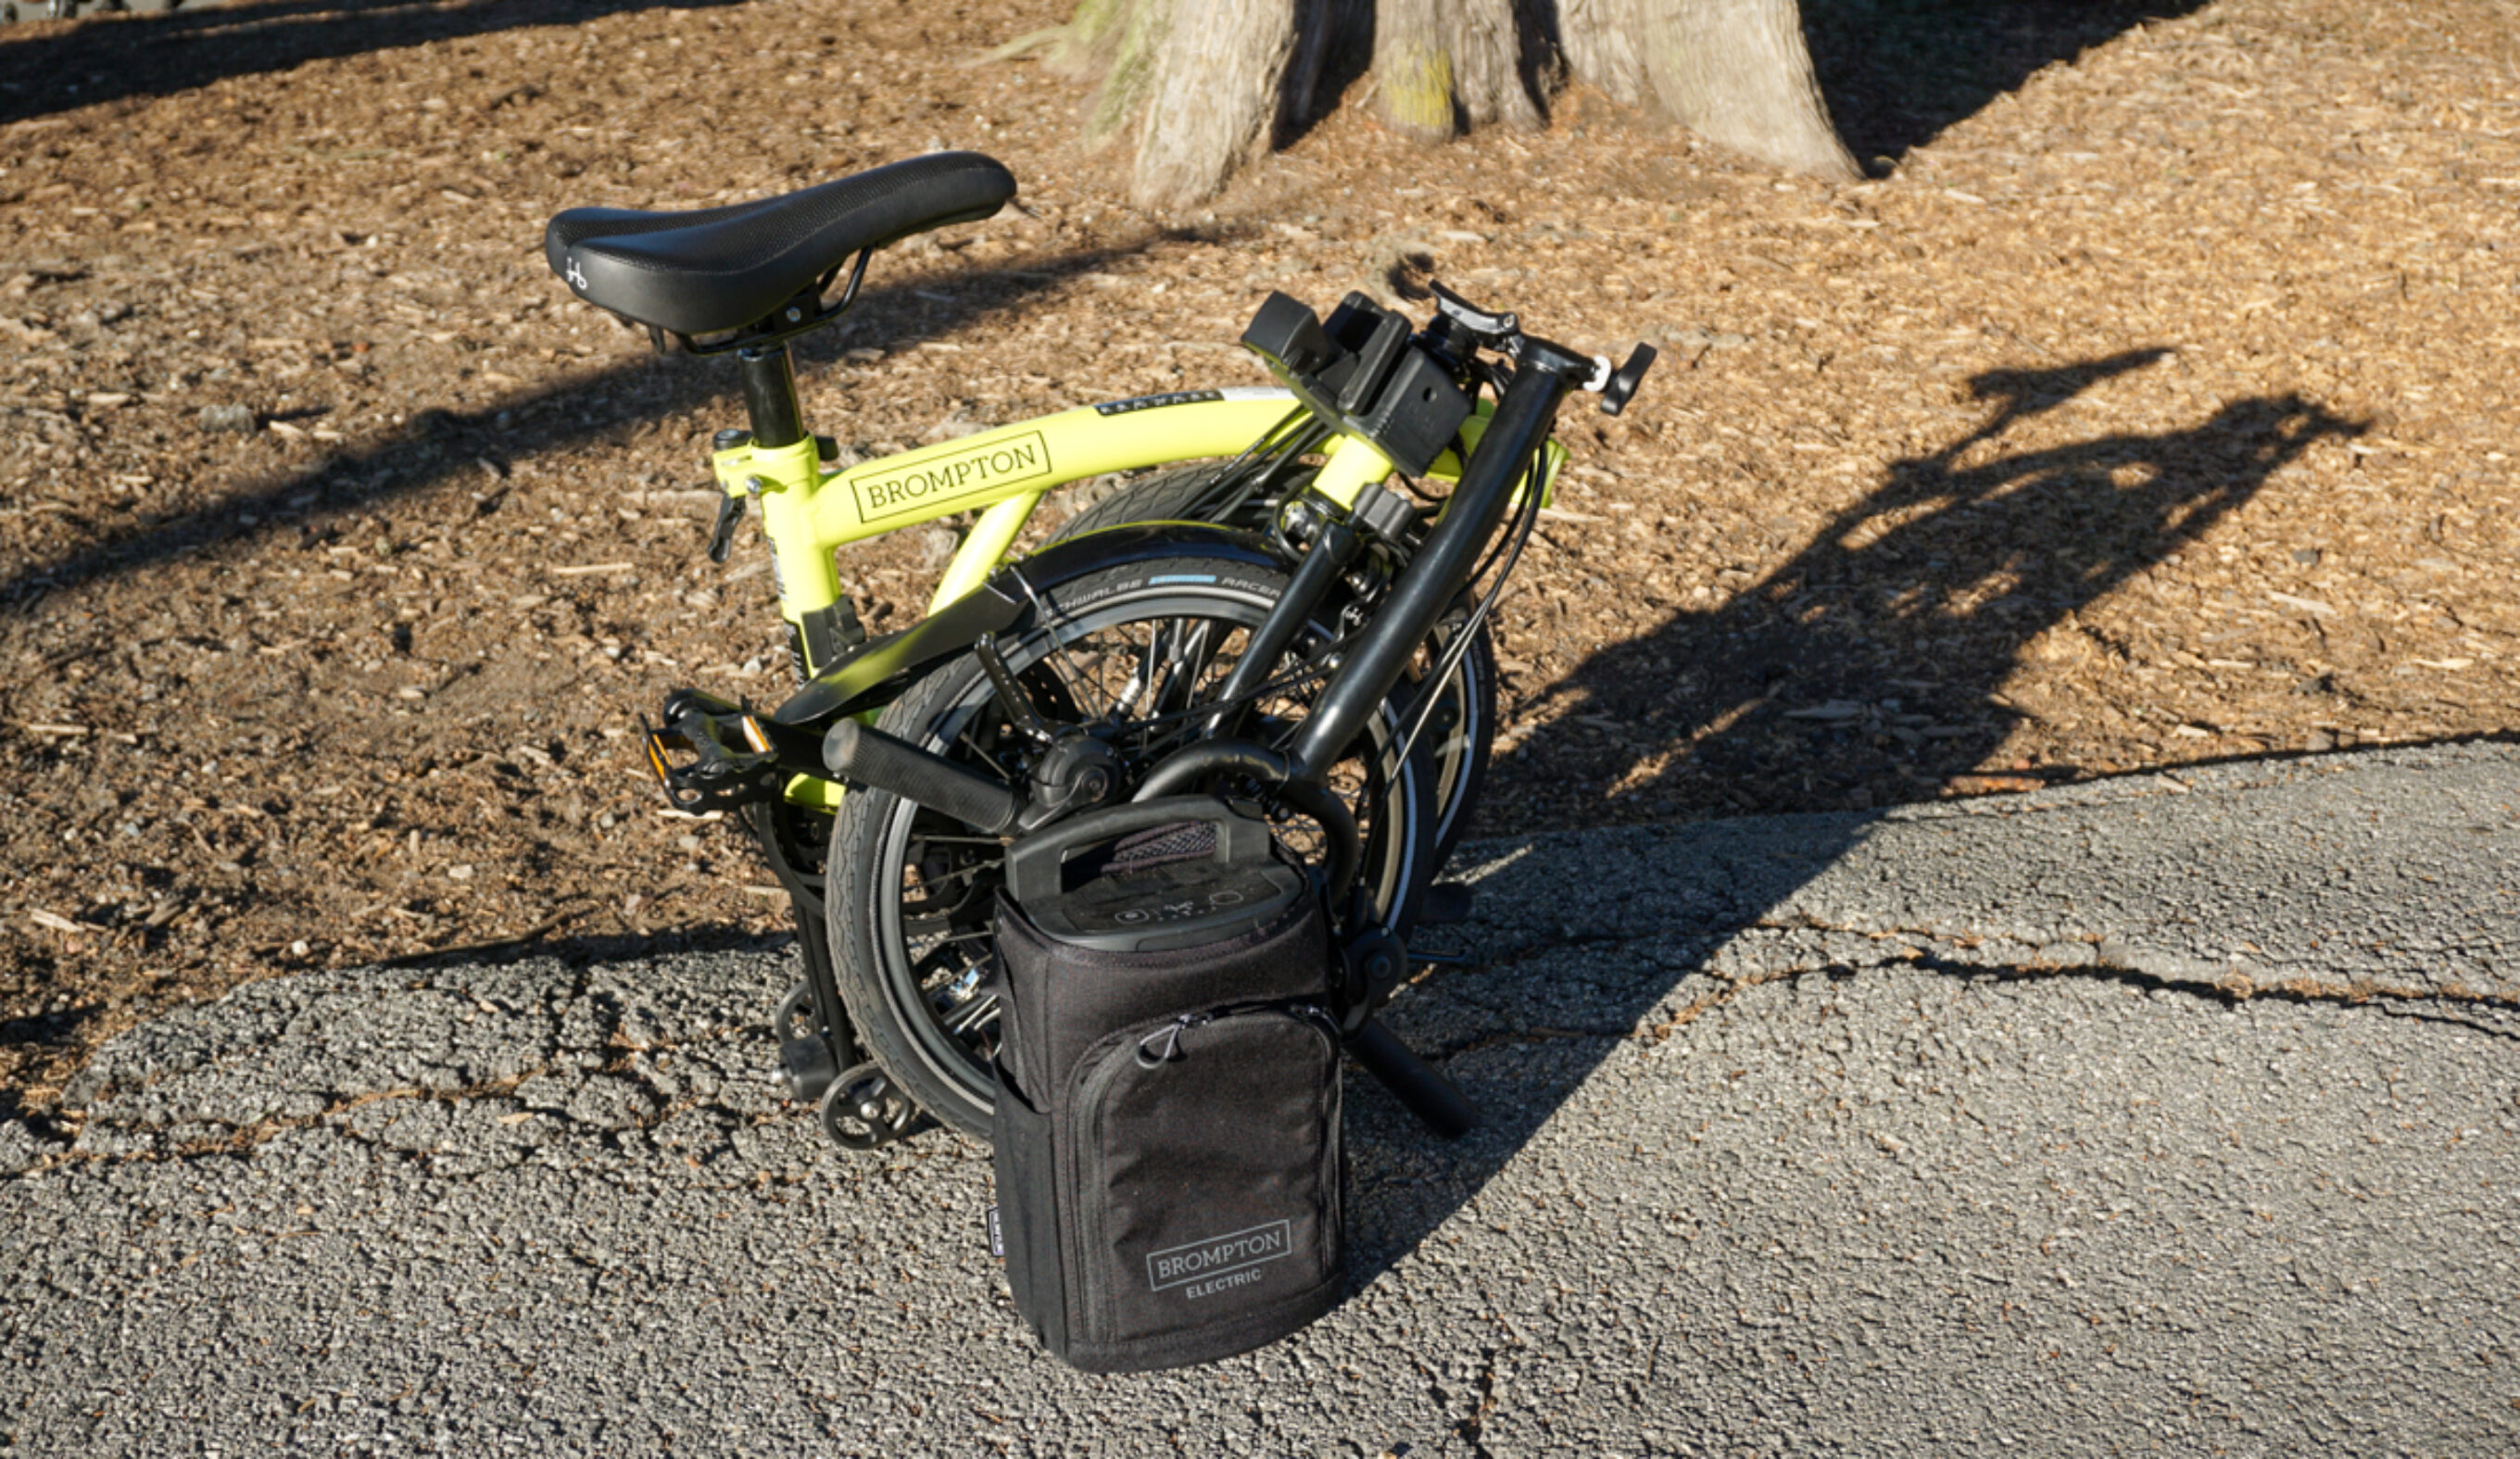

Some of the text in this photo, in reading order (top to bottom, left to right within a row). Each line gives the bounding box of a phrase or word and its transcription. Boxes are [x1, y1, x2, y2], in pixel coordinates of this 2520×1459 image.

[867, 444, 1037, 509] BROMPTON
[1157, 1229, 1281, 1280] BROMPTON
[1185, 1268, 1263, 1300] ELECTRIC
